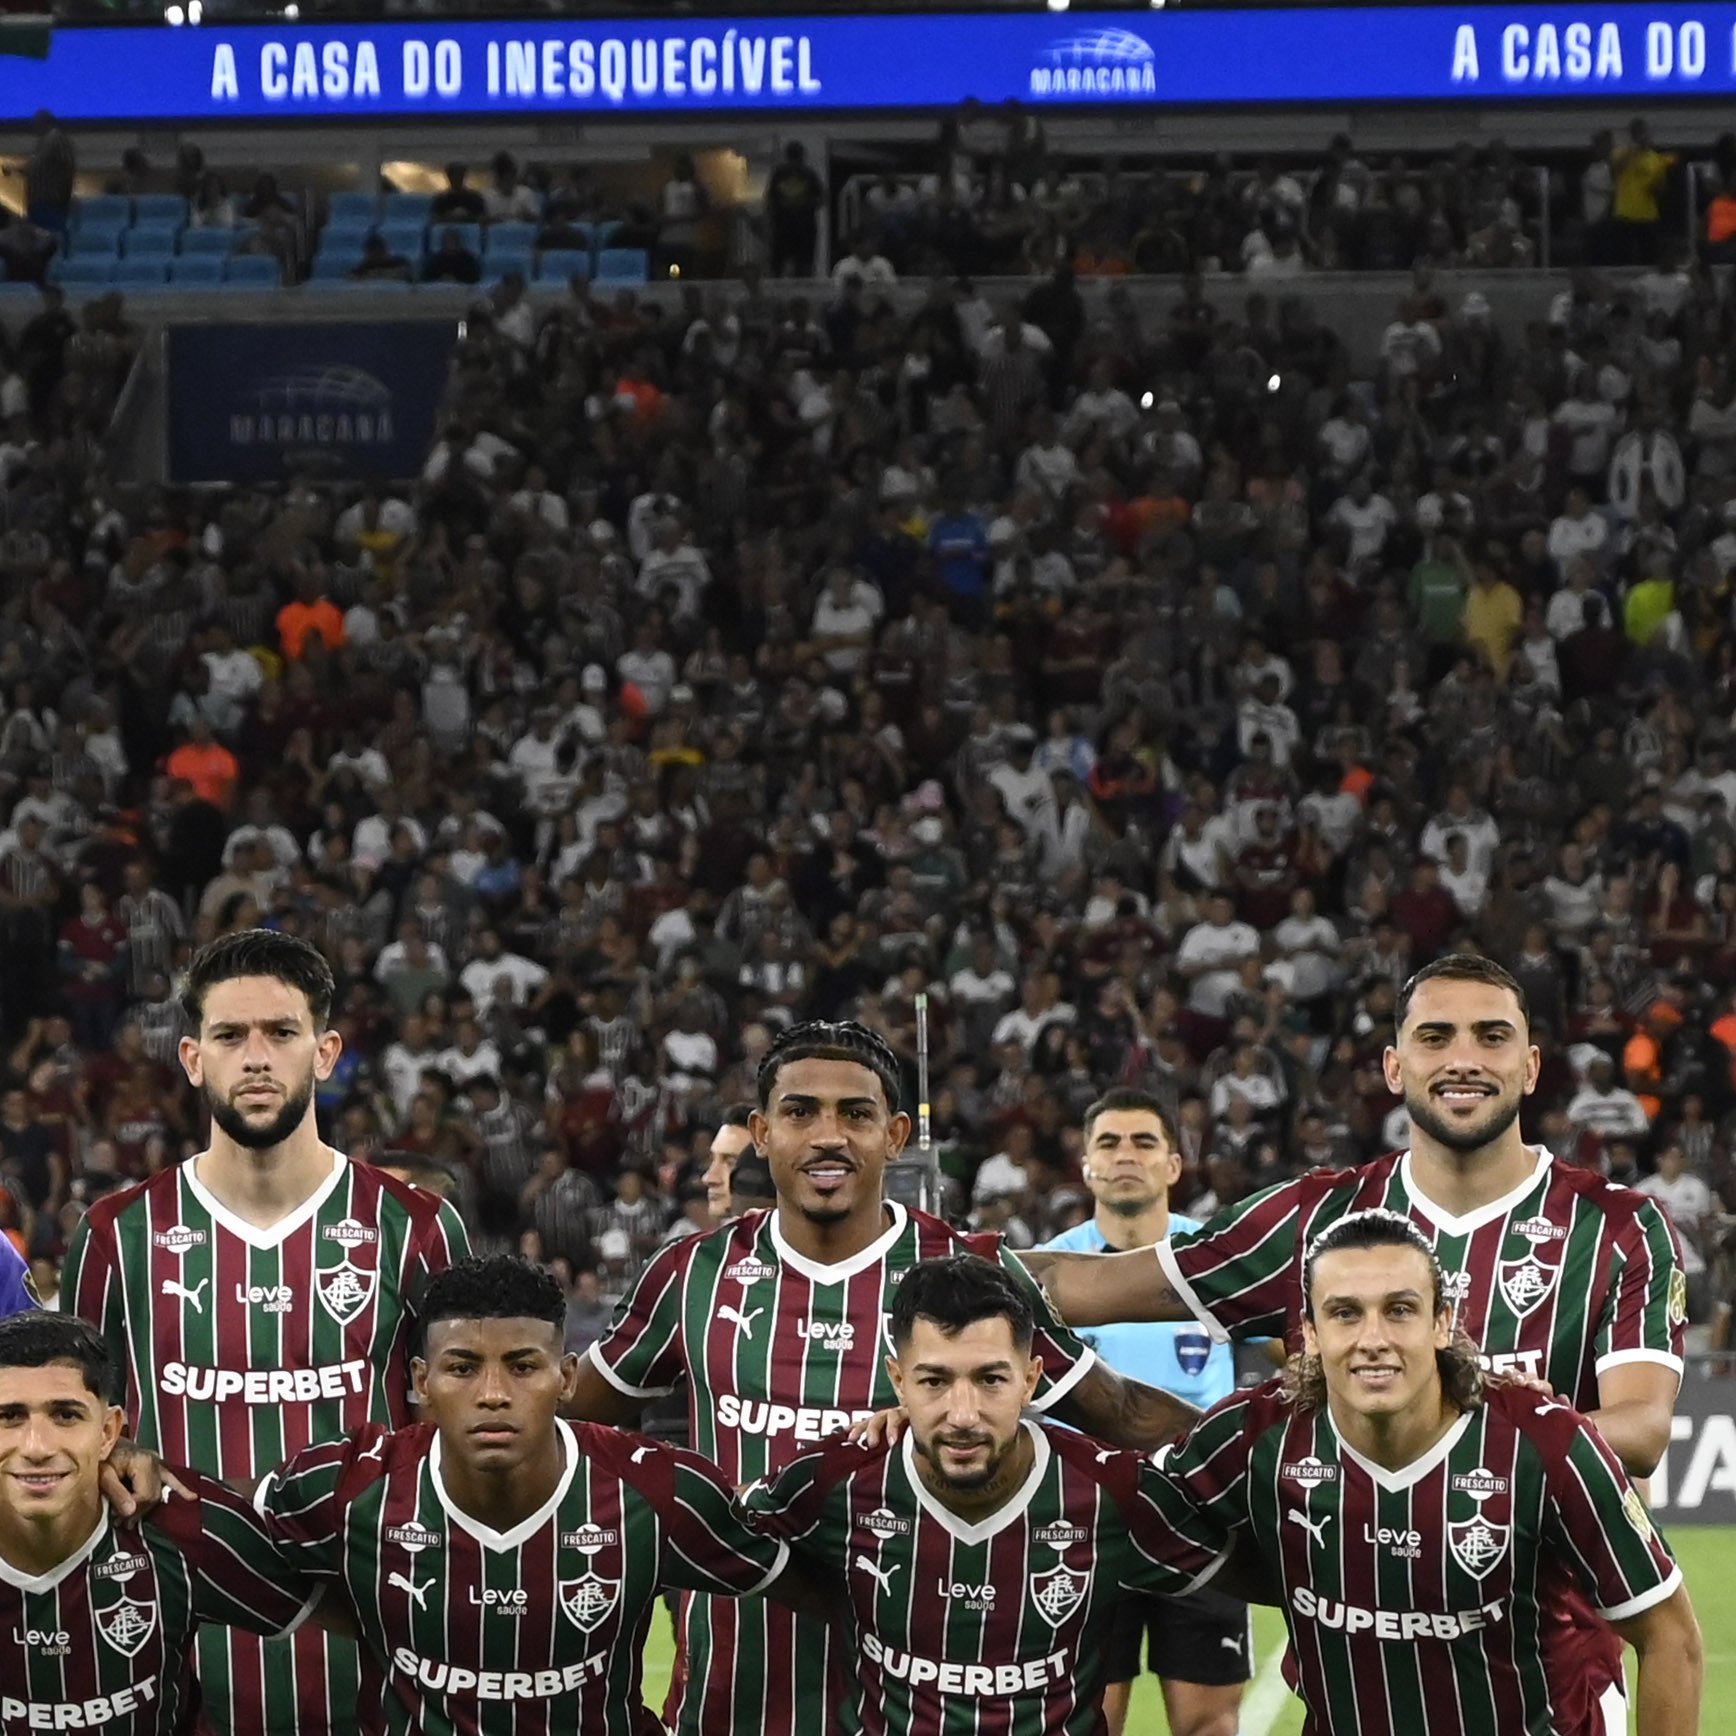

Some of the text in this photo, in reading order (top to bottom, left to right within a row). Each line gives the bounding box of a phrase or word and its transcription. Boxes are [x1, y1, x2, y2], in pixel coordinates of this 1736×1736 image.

[1453, 26, 1480, 81] A
[1503, 24, 1623, 81] CASA
[1648, 22, 1706, 79] DO
[213, 30, 822, 102] A CASA DO INESQUECÍVEL
[156, 1231, 205, 1246] FRESCATTO
[325, 1226, 376, 1241] FRESCATTO
[235, 1283, 293, 1303] Leve
[797, 1318, 855, 1339] Leve
[160, 1359, 367, 1404] SUPERBET
[1284, 1465, 1335, 1480] FRESCATTO
[1454, 1476, 1506, 1492] FRESCATTO
[858, 1514, 909, 1533] FRESCATTO
[1034, 1527, 1085, 1541] FRESCATTO
[388, 1528, 439, 1545] FRESCATTO
[564, 1532, 615, 1547] FRESCATTO
[1363, 1523, 1422, 1546] Leve
[96, 1557, 147, 1576] FRESCATTO
[469, 1585, 528, 1606] Leve
[937, 1578, 996, 1599] Leve
[1292, 1586, 1506, 1641] SUPERBET
[13, 1626, 70, 1647] Leve
[393, 1646, 608, 1700] SUPERBET
[862, 1633, 1068, 1696] SUPERBET
